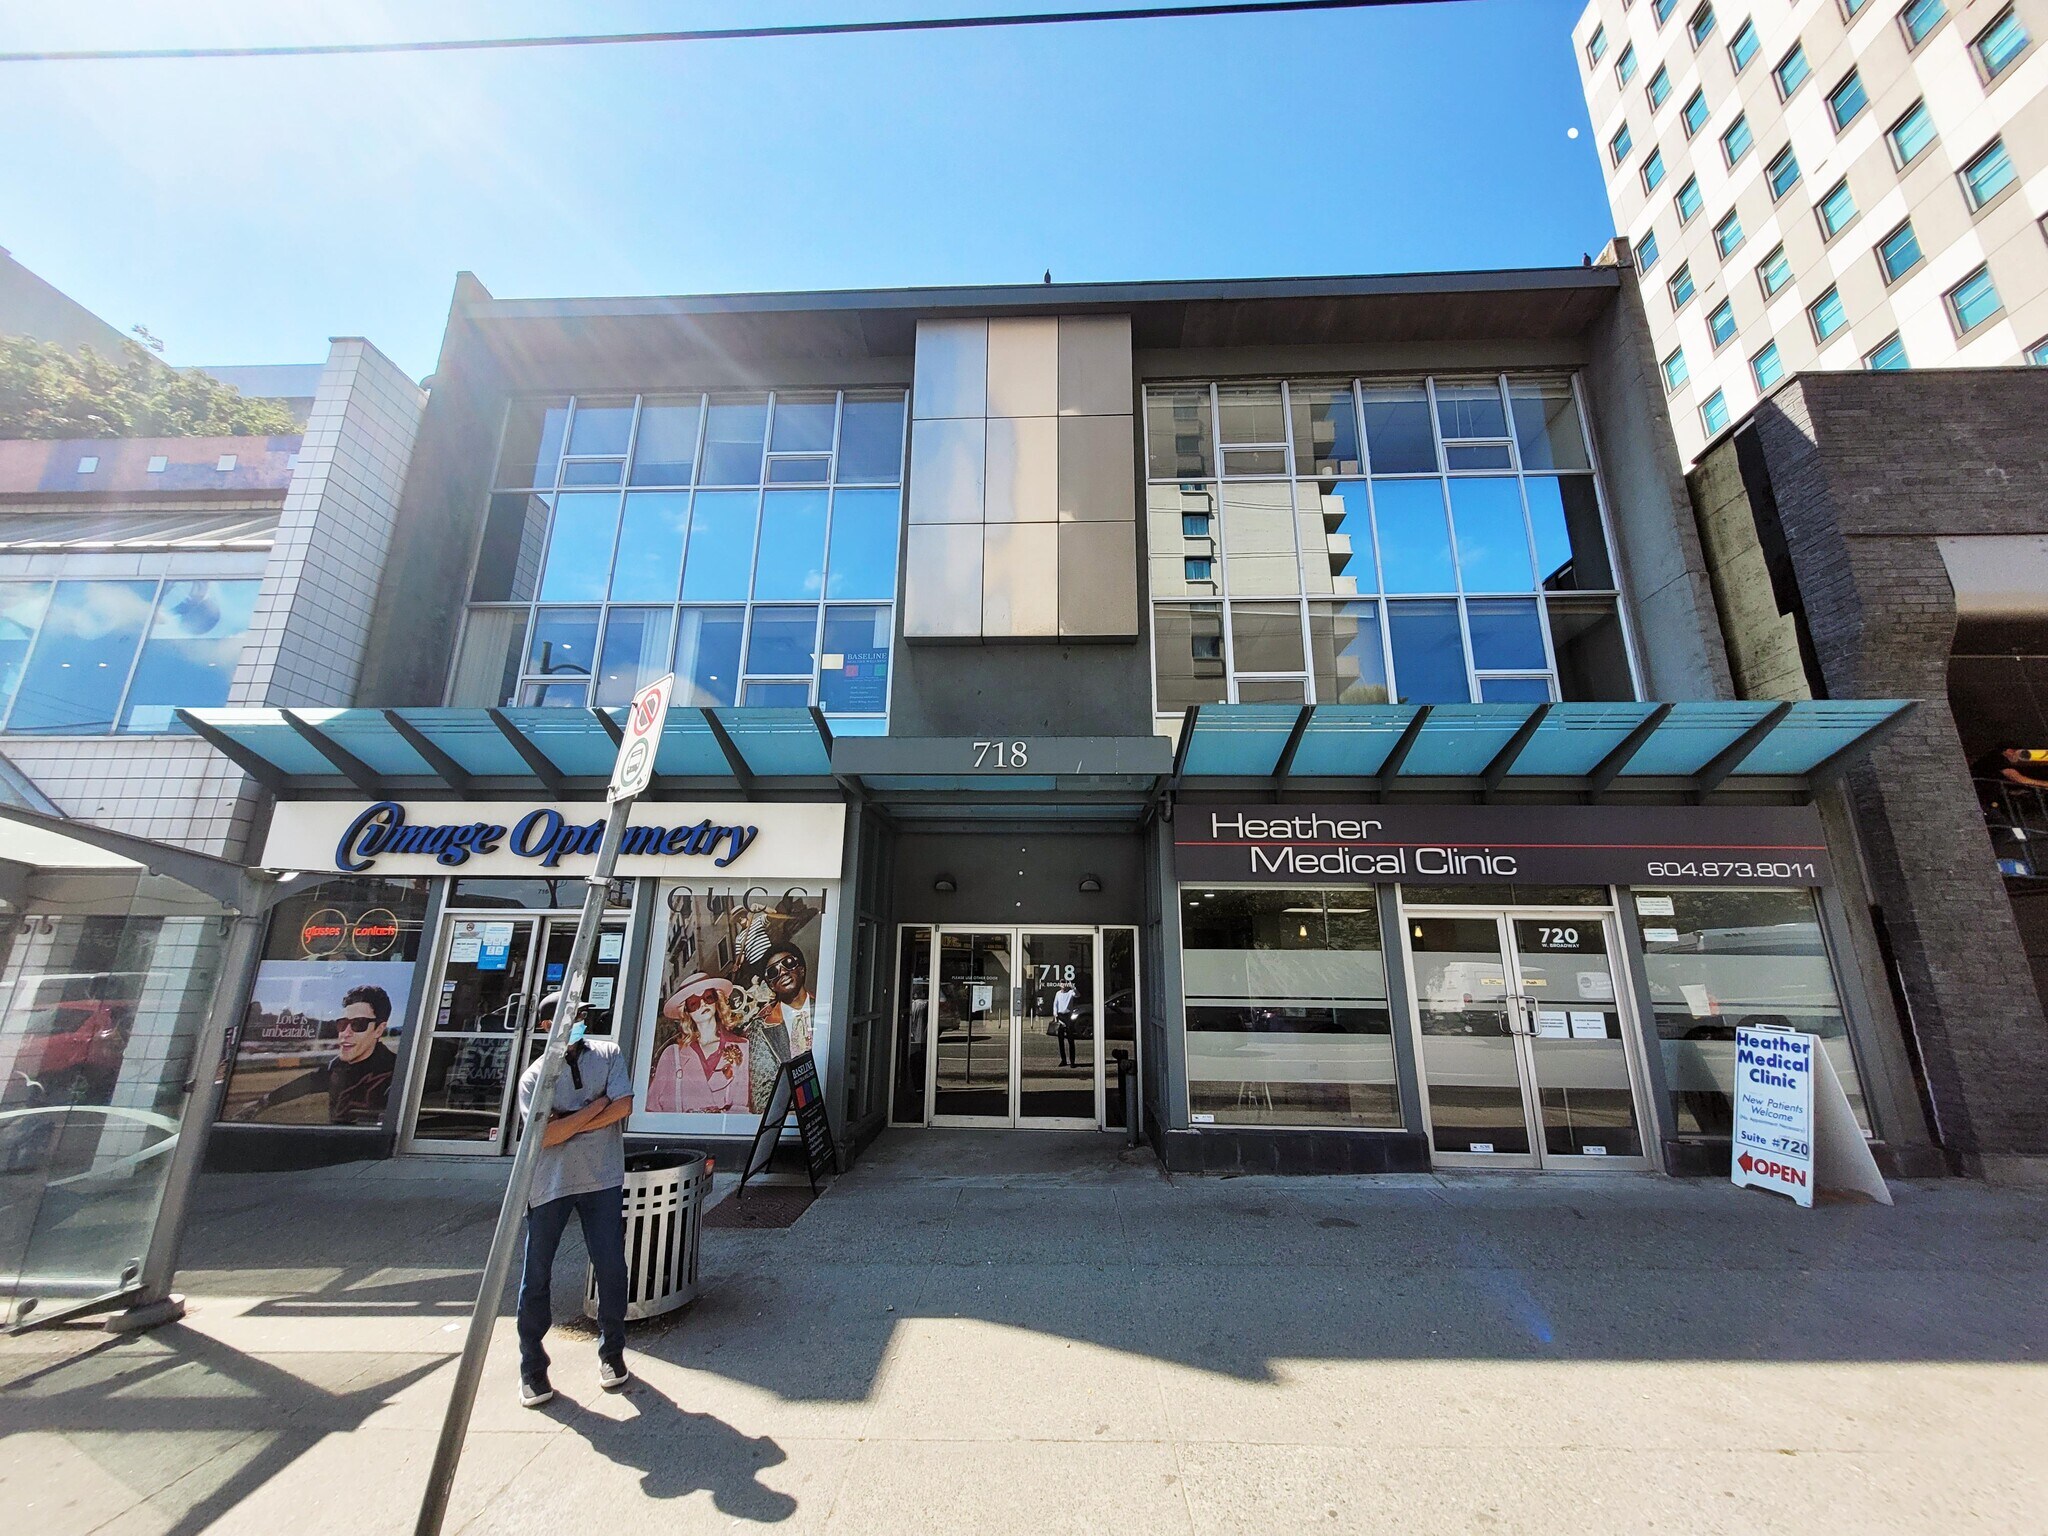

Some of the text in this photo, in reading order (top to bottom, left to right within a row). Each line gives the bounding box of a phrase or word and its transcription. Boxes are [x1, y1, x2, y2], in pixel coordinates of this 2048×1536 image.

[973, 741, 1028, 768] 718
[1211, 812, 1382, 839] Heather
[510, 808, 758, 867] Optmetry
[1250, 846, 1518, 875] Medical Clinic
[1647, 862, 1816, 878] 604.873.8011
[304, 926, 341, 945] glasses
[354, 926, 396, 937] contacts
[1538, 928, 1579, 943] 720
[1039, 964, 1076, 981] 718
[275, 1013, 309, 1025] Love is
[261, 1025, 317, 1039] unbeatable.
[1737, 1032, 1810, 1054] Heather
[1738, 1049, 1809, 1073] Medical
[1749, 1068, 1797, 1090] Clinic
[1742, 1093, 1804, 1114] New Patients
[1751, 1105, 1793, 1122] Welcome
[1741, 1130, 1809, 1156] Suite #720
[1754, 1158, 1807, 1187] OPEN
